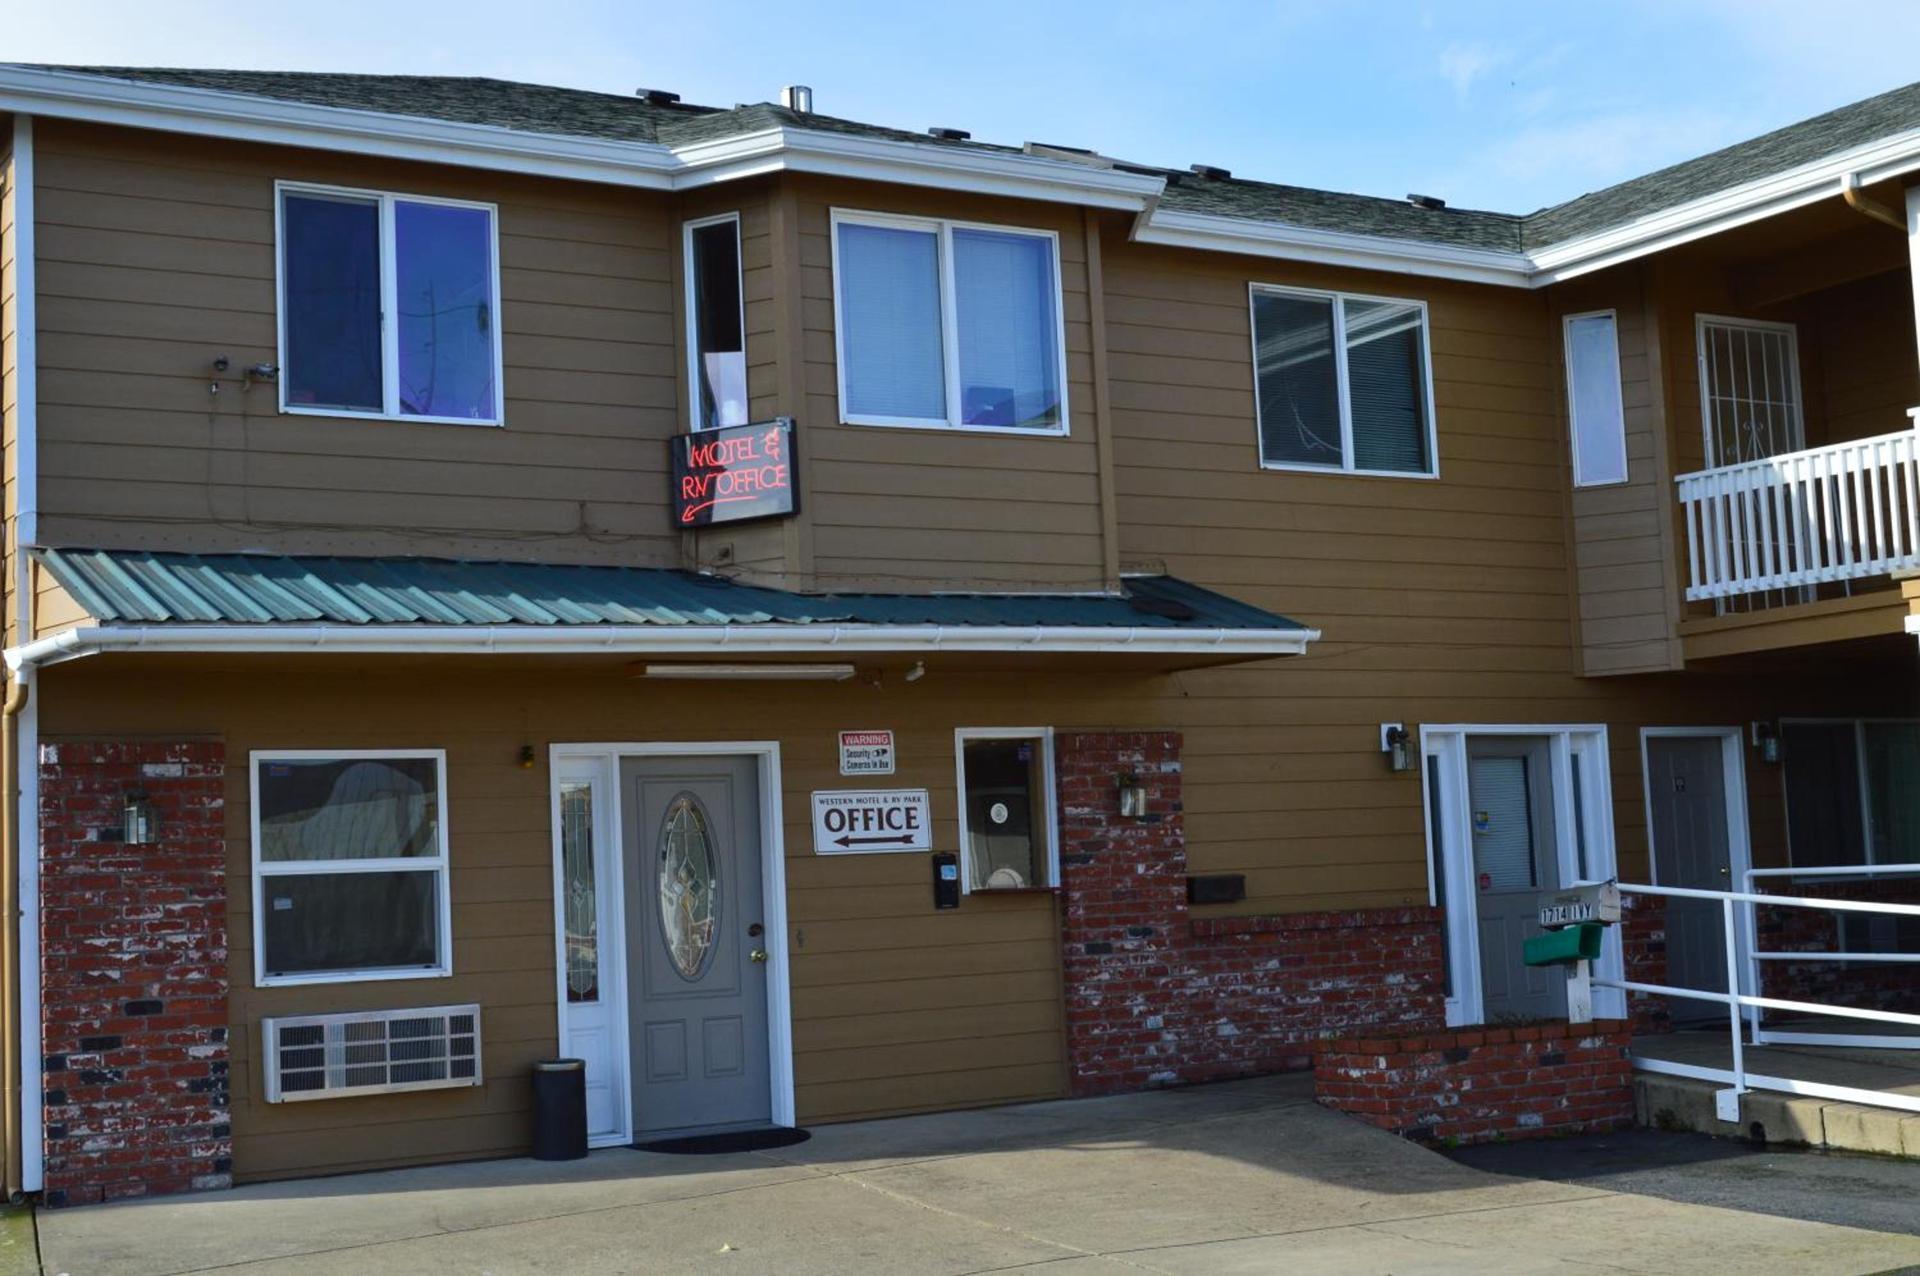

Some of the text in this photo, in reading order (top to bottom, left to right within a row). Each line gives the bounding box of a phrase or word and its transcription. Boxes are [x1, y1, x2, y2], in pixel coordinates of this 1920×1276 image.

[690, 427, 780, 468] MOTEL &
[682, 464, 787, 499] RV OFFICE
[844, 734, 889, 745] WARNING
[846, 748, 871, 759] Security
[846, 760, 871, 770] Cameras
[879, 759, 889, 769] Use
[818, 797, 854, 806] WESTERN
[856, 797, 880, 805] MOTEL
[824, 807, 920, 832] OFFICE
[1543, 903, 1591, 922] 1714 IVY
